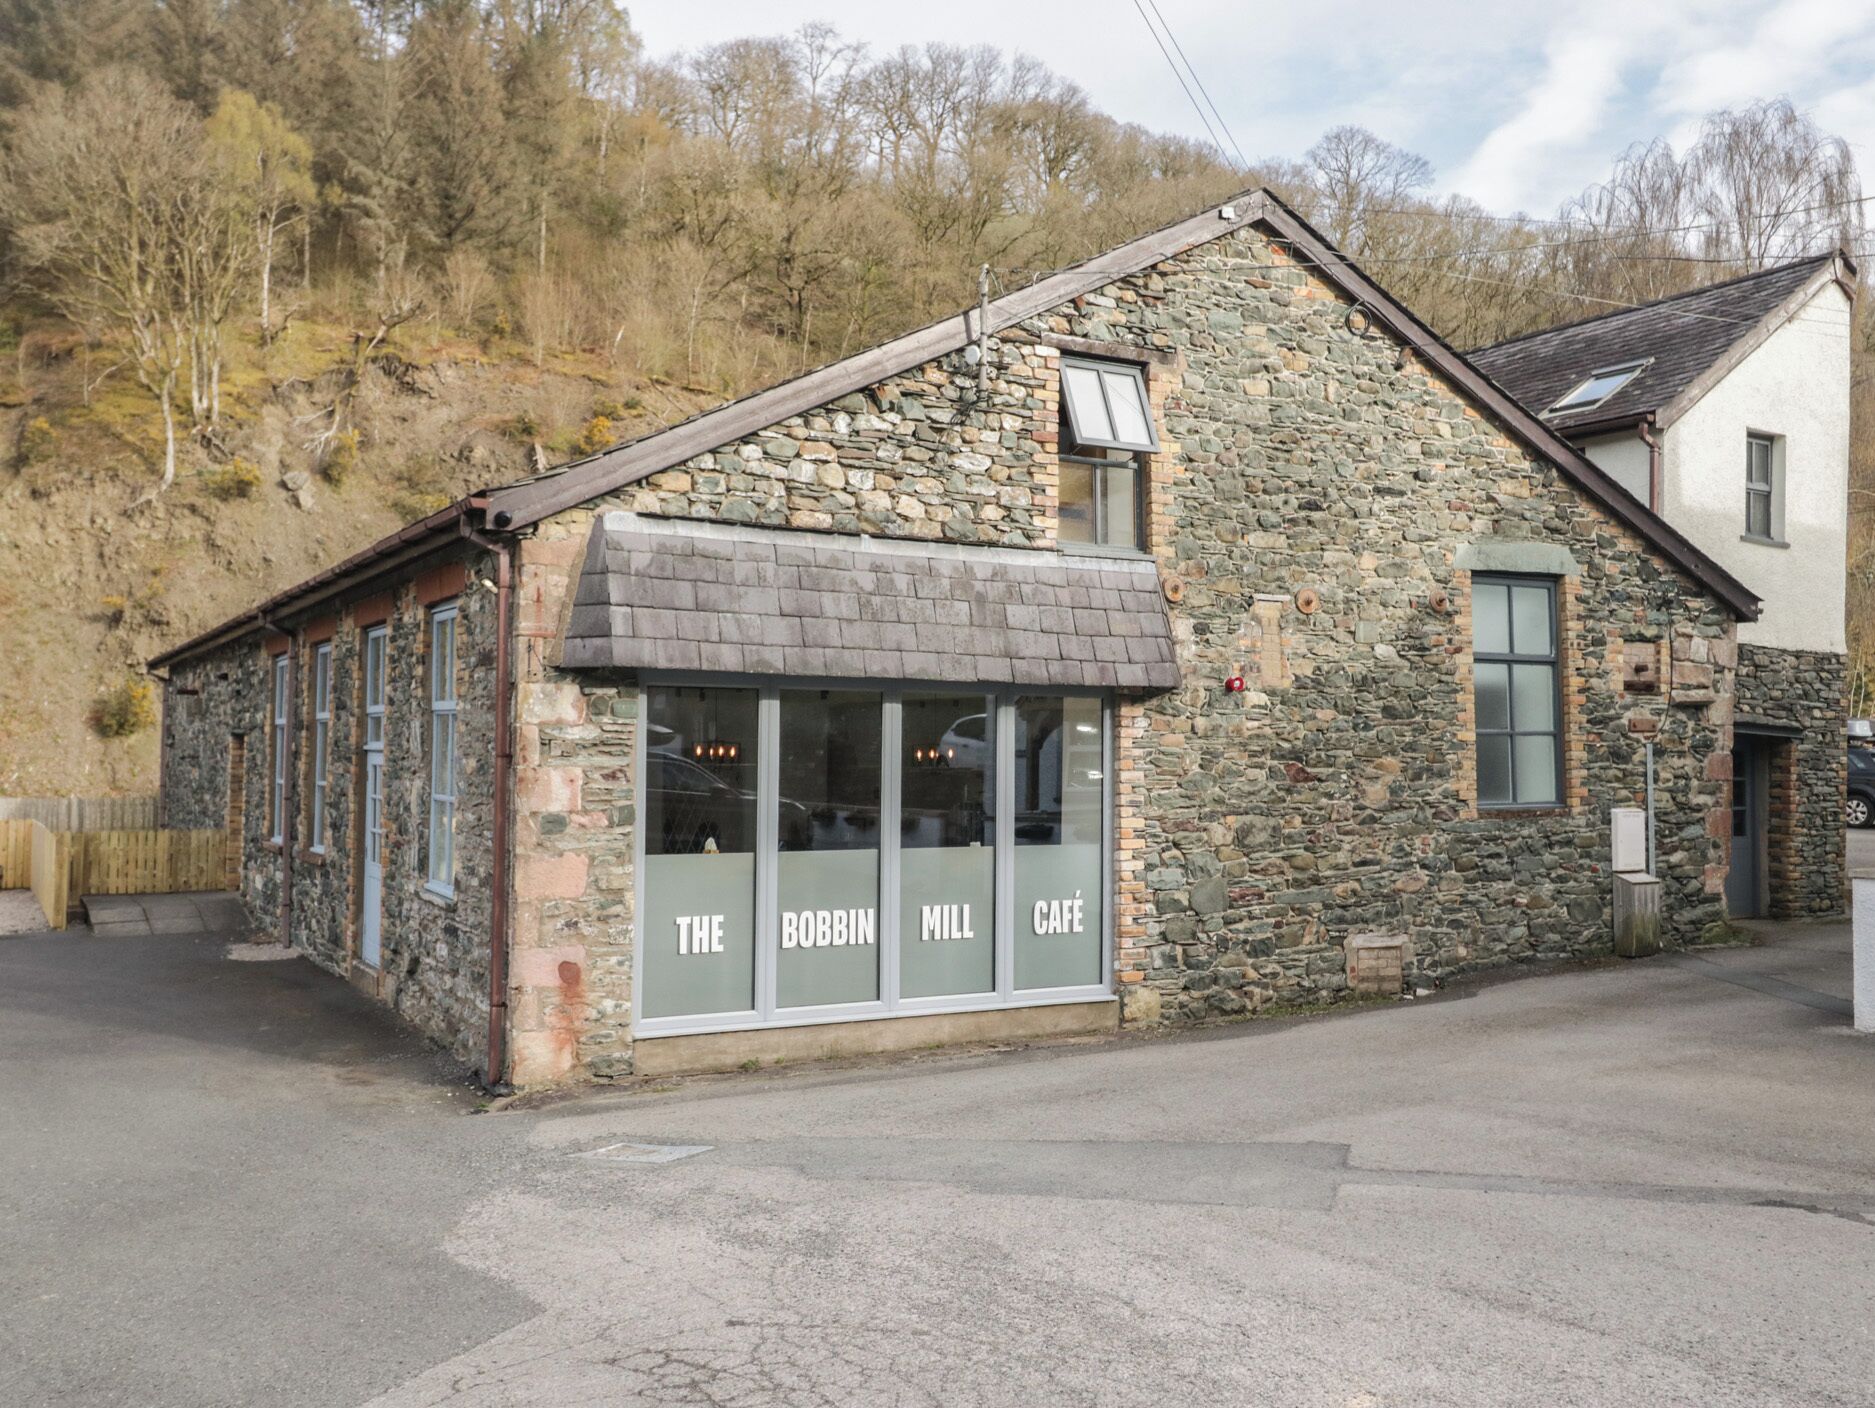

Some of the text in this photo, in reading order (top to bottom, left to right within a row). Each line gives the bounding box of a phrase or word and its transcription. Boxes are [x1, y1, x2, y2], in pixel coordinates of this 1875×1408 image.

[675, 890, 1084, 955] THE BOBBIN MILL CAFÉ
